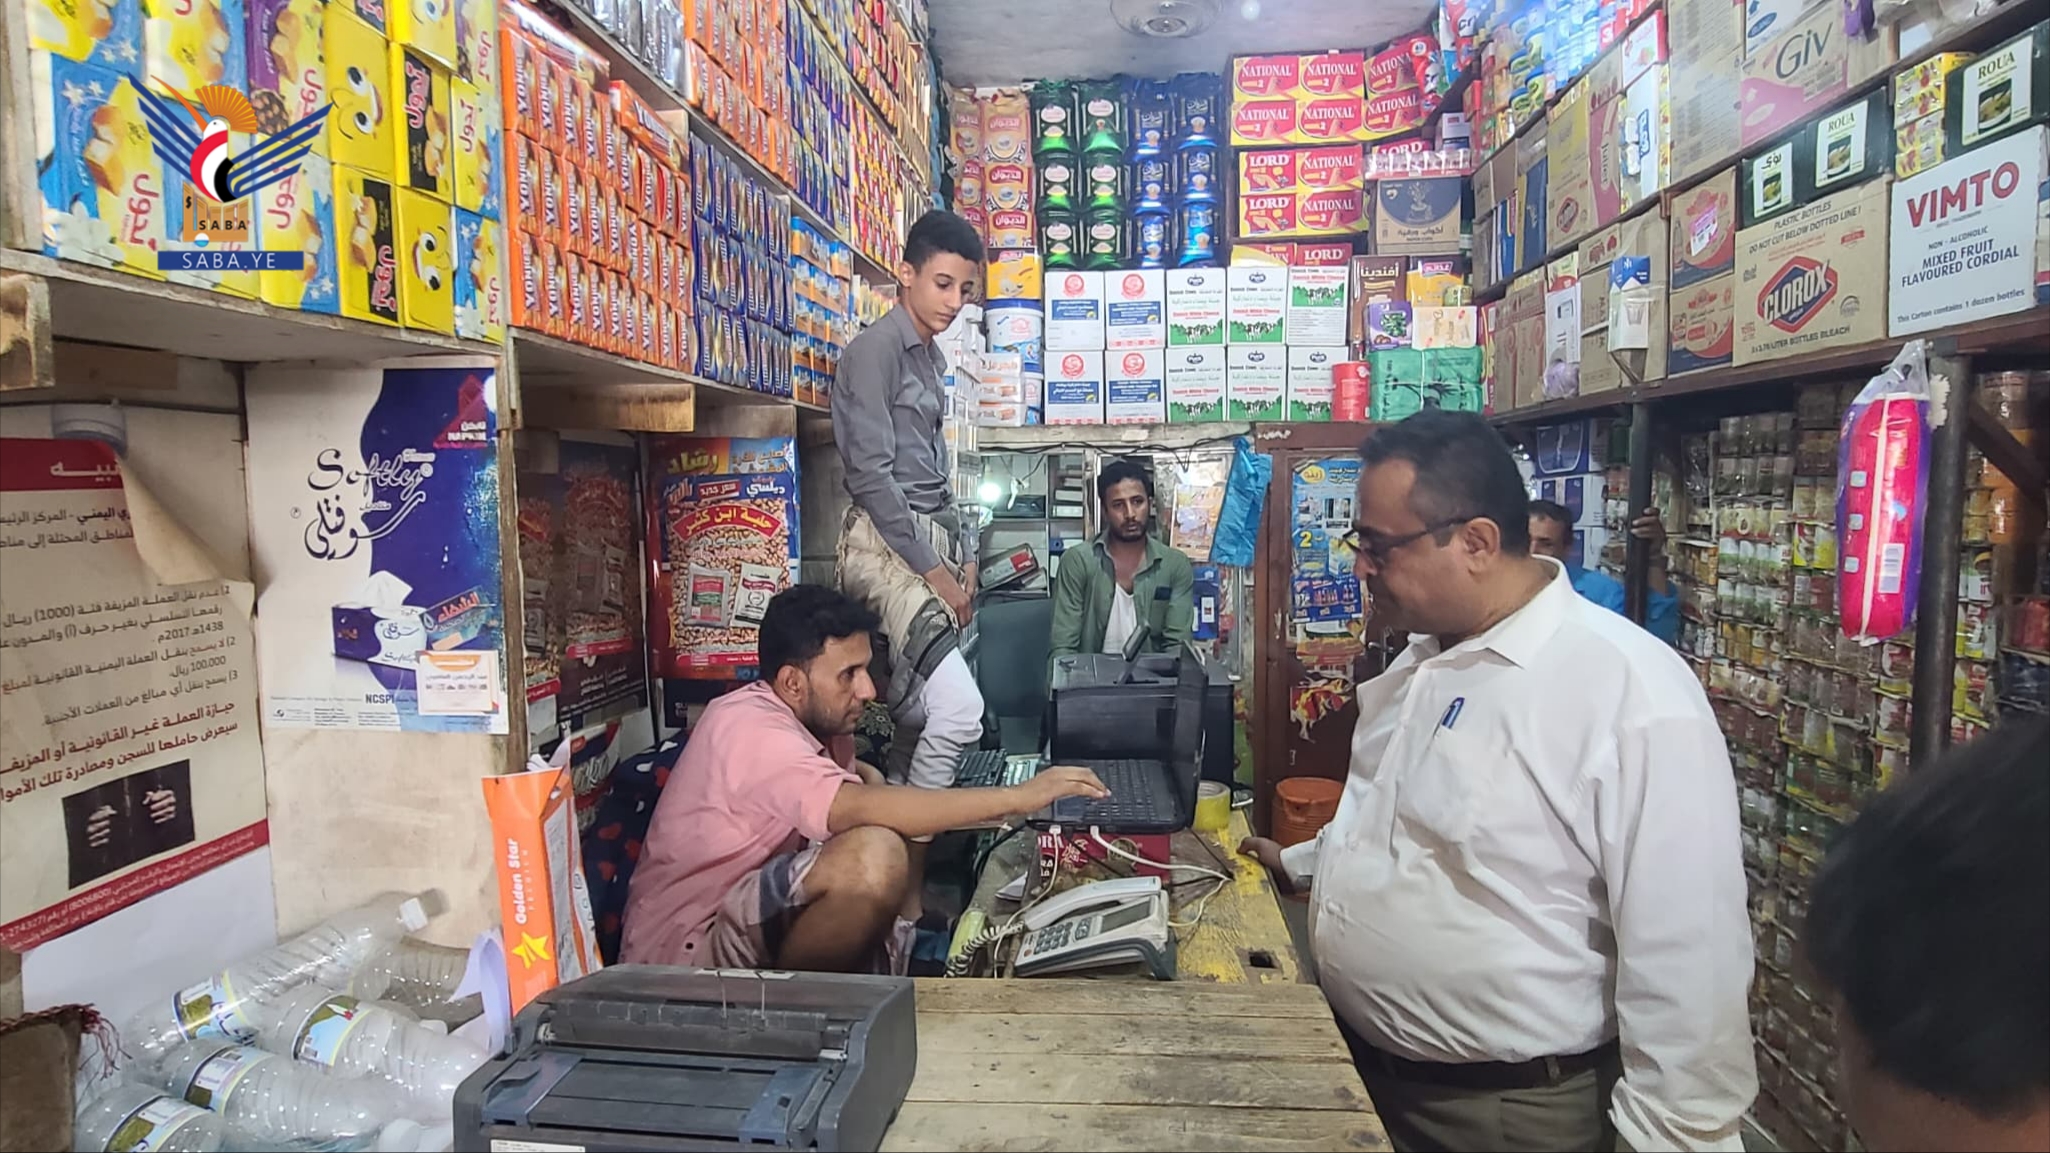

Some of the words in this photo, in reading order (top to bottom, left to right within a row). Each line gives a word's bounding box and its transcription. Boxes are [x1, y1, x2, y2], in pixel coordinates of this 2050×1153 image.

[1776, 22, 1834, 79] Giv
[1241, 63, 1293, 77] NATIONAL
[1306, 61, 1357, 76] NATIONAL
[1369, 51, 1412, 79] NATIONA
[1978, 50, 2016, 80] ROUA
[1239, 108, 1290, 121] NATIONAL
[1303, 106, 1355, 120] NATIONAL
[1367, 94, 1420, 115] NATIONAL
[1826, 110, 1855, 134] ROUA
[1250, 154, 1291, 167] LORD
[1303, 155, 1355, 170] NATIONAL
[991, 169, 1022, 181] الديوان
[1249, 197, 1291, 210] LORD
[1906, 160, 2020, 228] VIMTO
[1303, 199, 1355, 212] NATIONAL
[1773, 212, 1800, 230] PLASTIC
[1801, 201, 1832, 221] BOTTLES
[995, 215, 1027, 226] الديوان
[1758, 238, 1771, 249] NOT
[1784, 224, 1809, 241] BELOW
[1809, 214, 1839, 232] DOTTED
[1840, 207, 1858, 221] LINE
[1928, 240, 1944, 250] NON
[1949, 225, 1989, 245] ALCOHOLIC
[1304, 248, 1344, 260] LORD
[1922, 249, 1957, 269] MIXED
[1960, 238, 1994, 259] FRUIT
[1360, 261, 1399, 280] أفندينا
[1901, 261, 1963, 288] FLAVOURED
[1966, 245, 2020, 269] CORDIAL
[1762, 259, 1831, 327] CLOROX
[1911, 309, 1933, 321] Carton
[1933, 304, 1963, 316] contains
[1971, 296, 1995, 307] dozen
[1996, 288, 2025, 302] bottles
[1820, 324, 1851, 339] BLEACH
[308, 448, 424, 501] Softly
[33, 509, 67, 525] المركز
[76, 507, 115, 525] اليمني
[48, 530, 88, 544] المحتلة
[142, 592, 180, 605] العملة
[3, 613, 32, 628] ريال
[34, 604, 75, 622] (1000)
[126, 650, 158, 666] العملة
[162, 706, 204, 727] العملة
[205, 702, 235, 718] حيازة
[130, 717, 160, 739] غير
[200, 722, 238, 742] سيعرض
[68, 725, 128, 753] القانونية
[158, 732, 198, 751] حاملها
[53, 740, 65, 761] أو
[117, 741, 156, 765] للسجن
[0, 747, 51, 776] المزيف
[65, 757, 114, 781] ومصادرة
[39, 769, 63, 788] تلك
[507, 838, 521, 869] Star
[512, 873, 528, 925] Golden
